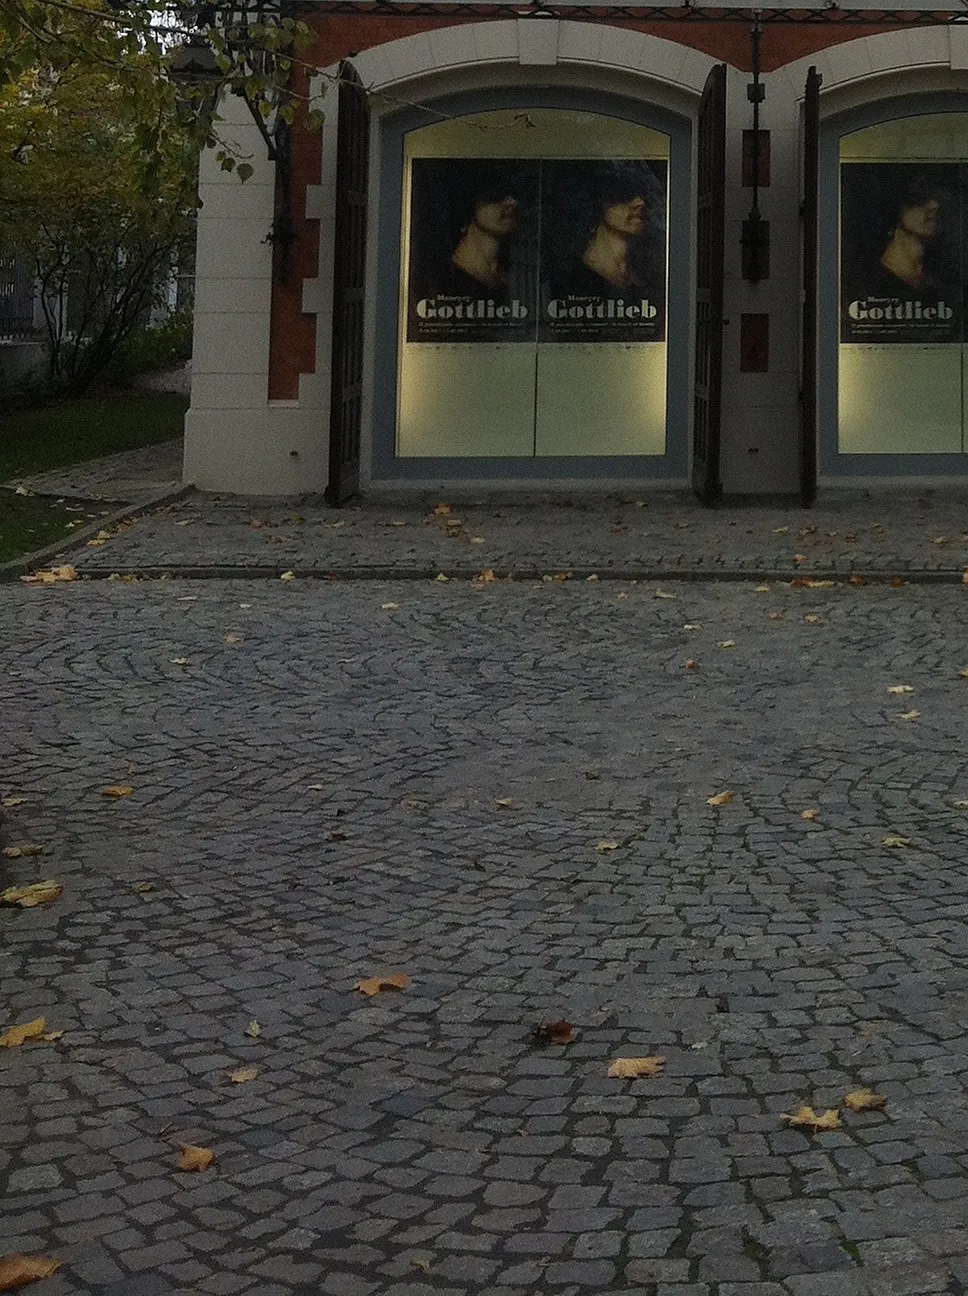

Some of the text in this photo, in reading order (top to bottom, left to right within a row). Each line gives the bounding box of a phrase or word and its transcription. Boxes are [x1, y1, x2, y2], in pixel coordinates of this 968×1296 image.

[416, 298, 529, 319] Gottlieb
[547, 298, 657, 319] Gottlieb
[848, 300, 953, 320] Gottlieb
